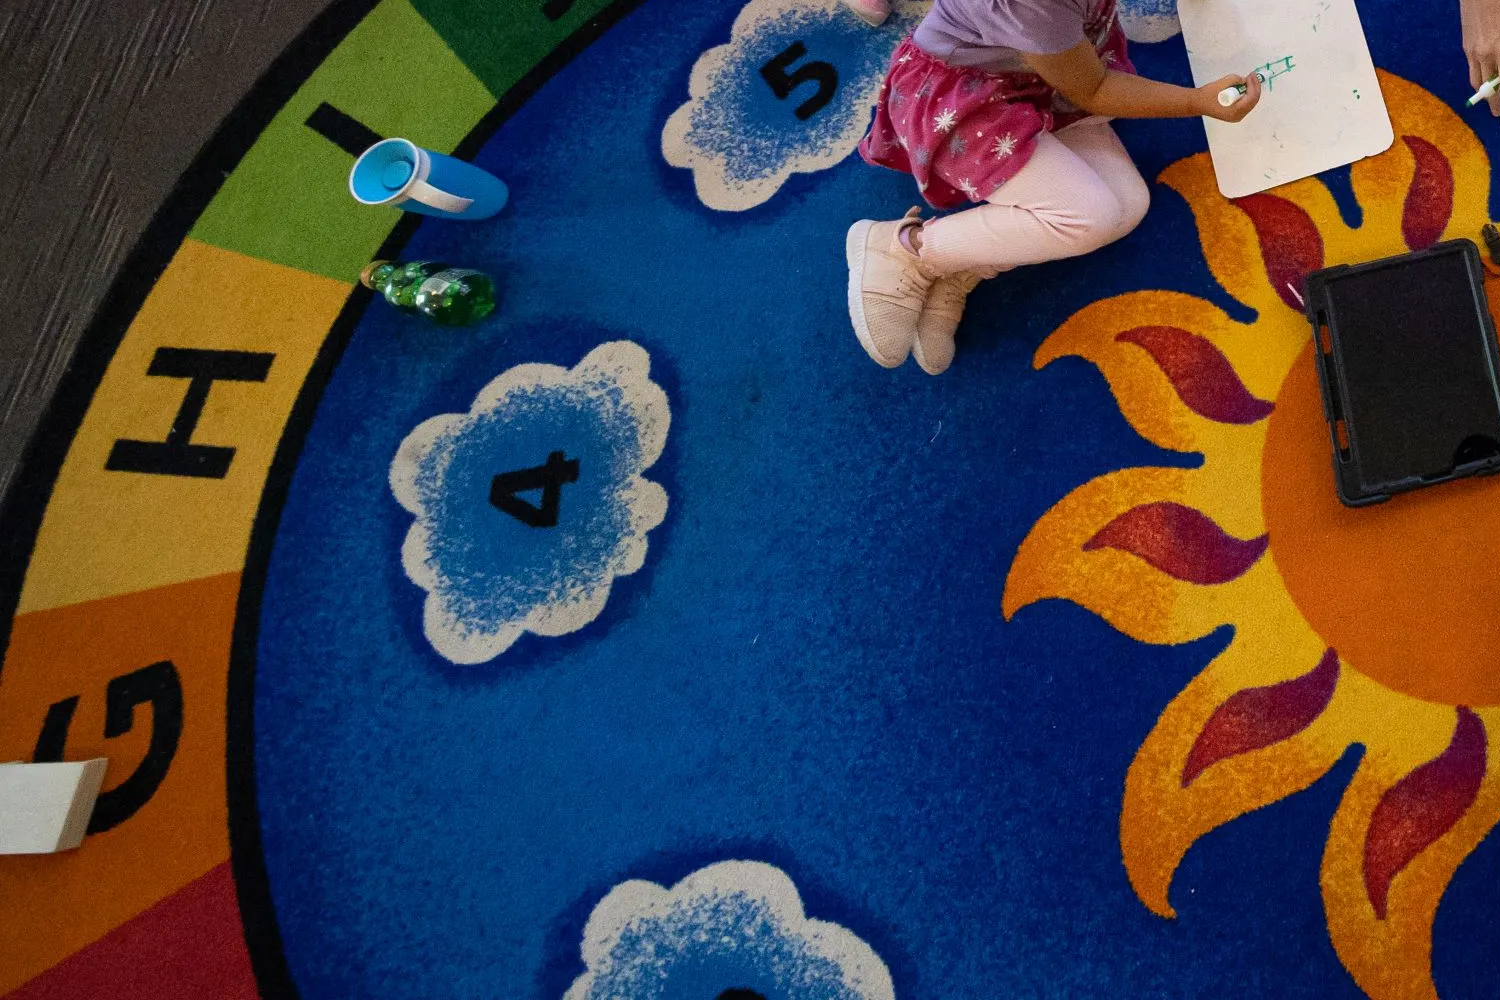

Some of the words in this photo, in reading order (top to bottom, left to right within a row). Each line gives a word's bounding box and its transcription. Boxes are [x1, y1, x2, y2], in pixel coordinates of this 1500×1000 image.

[760, 42, 838, 120] 5
[105, 347, 275, 479] H
[488, 450, 580, 528] 4
